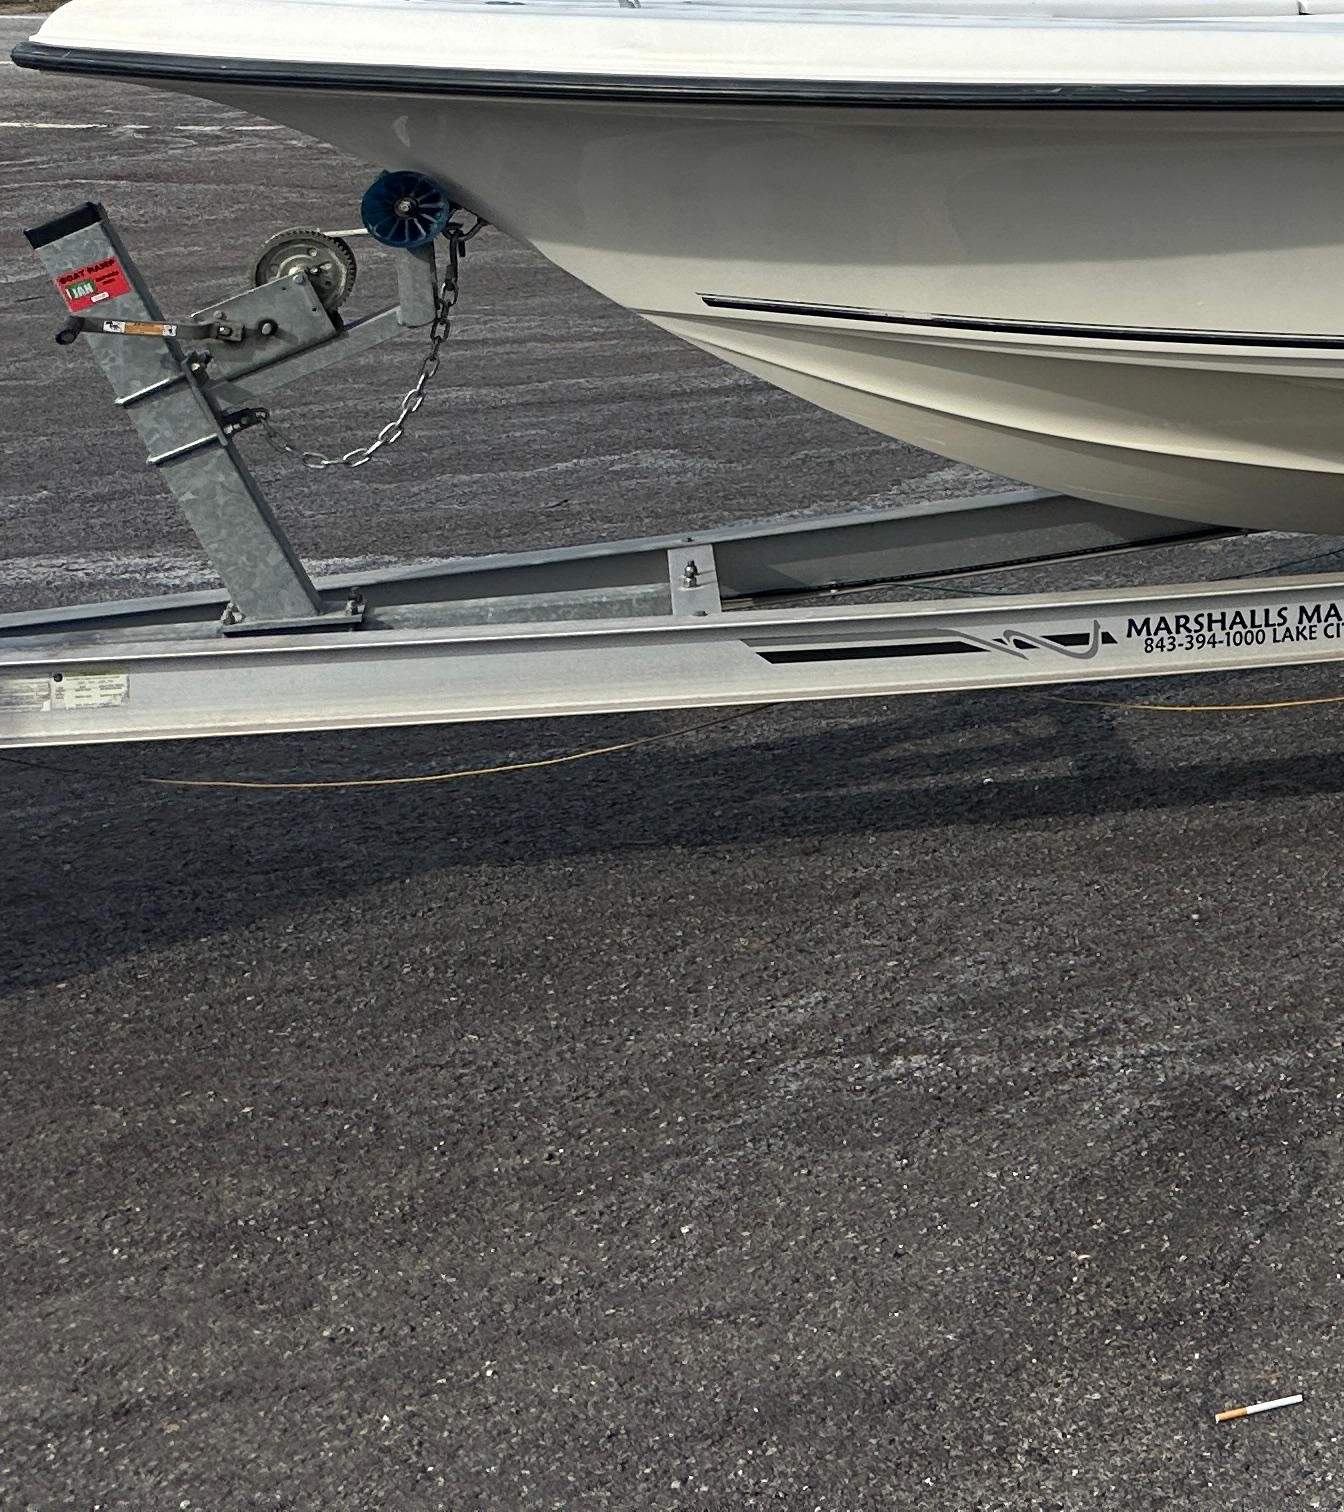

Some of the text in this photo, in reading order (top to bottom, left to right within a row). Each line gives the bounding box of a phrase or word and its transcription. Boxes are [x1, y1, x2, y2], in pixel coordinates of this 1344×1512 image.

[59, 270, 85, 284] BOAT
[87, 258, 115, 274] RAMP
[1126, 606, 1288, 638] MARSHALLS
[1144, 629, 1266, 654] 843-394-1000
[1272, 624, 1318, 643] LAKE
